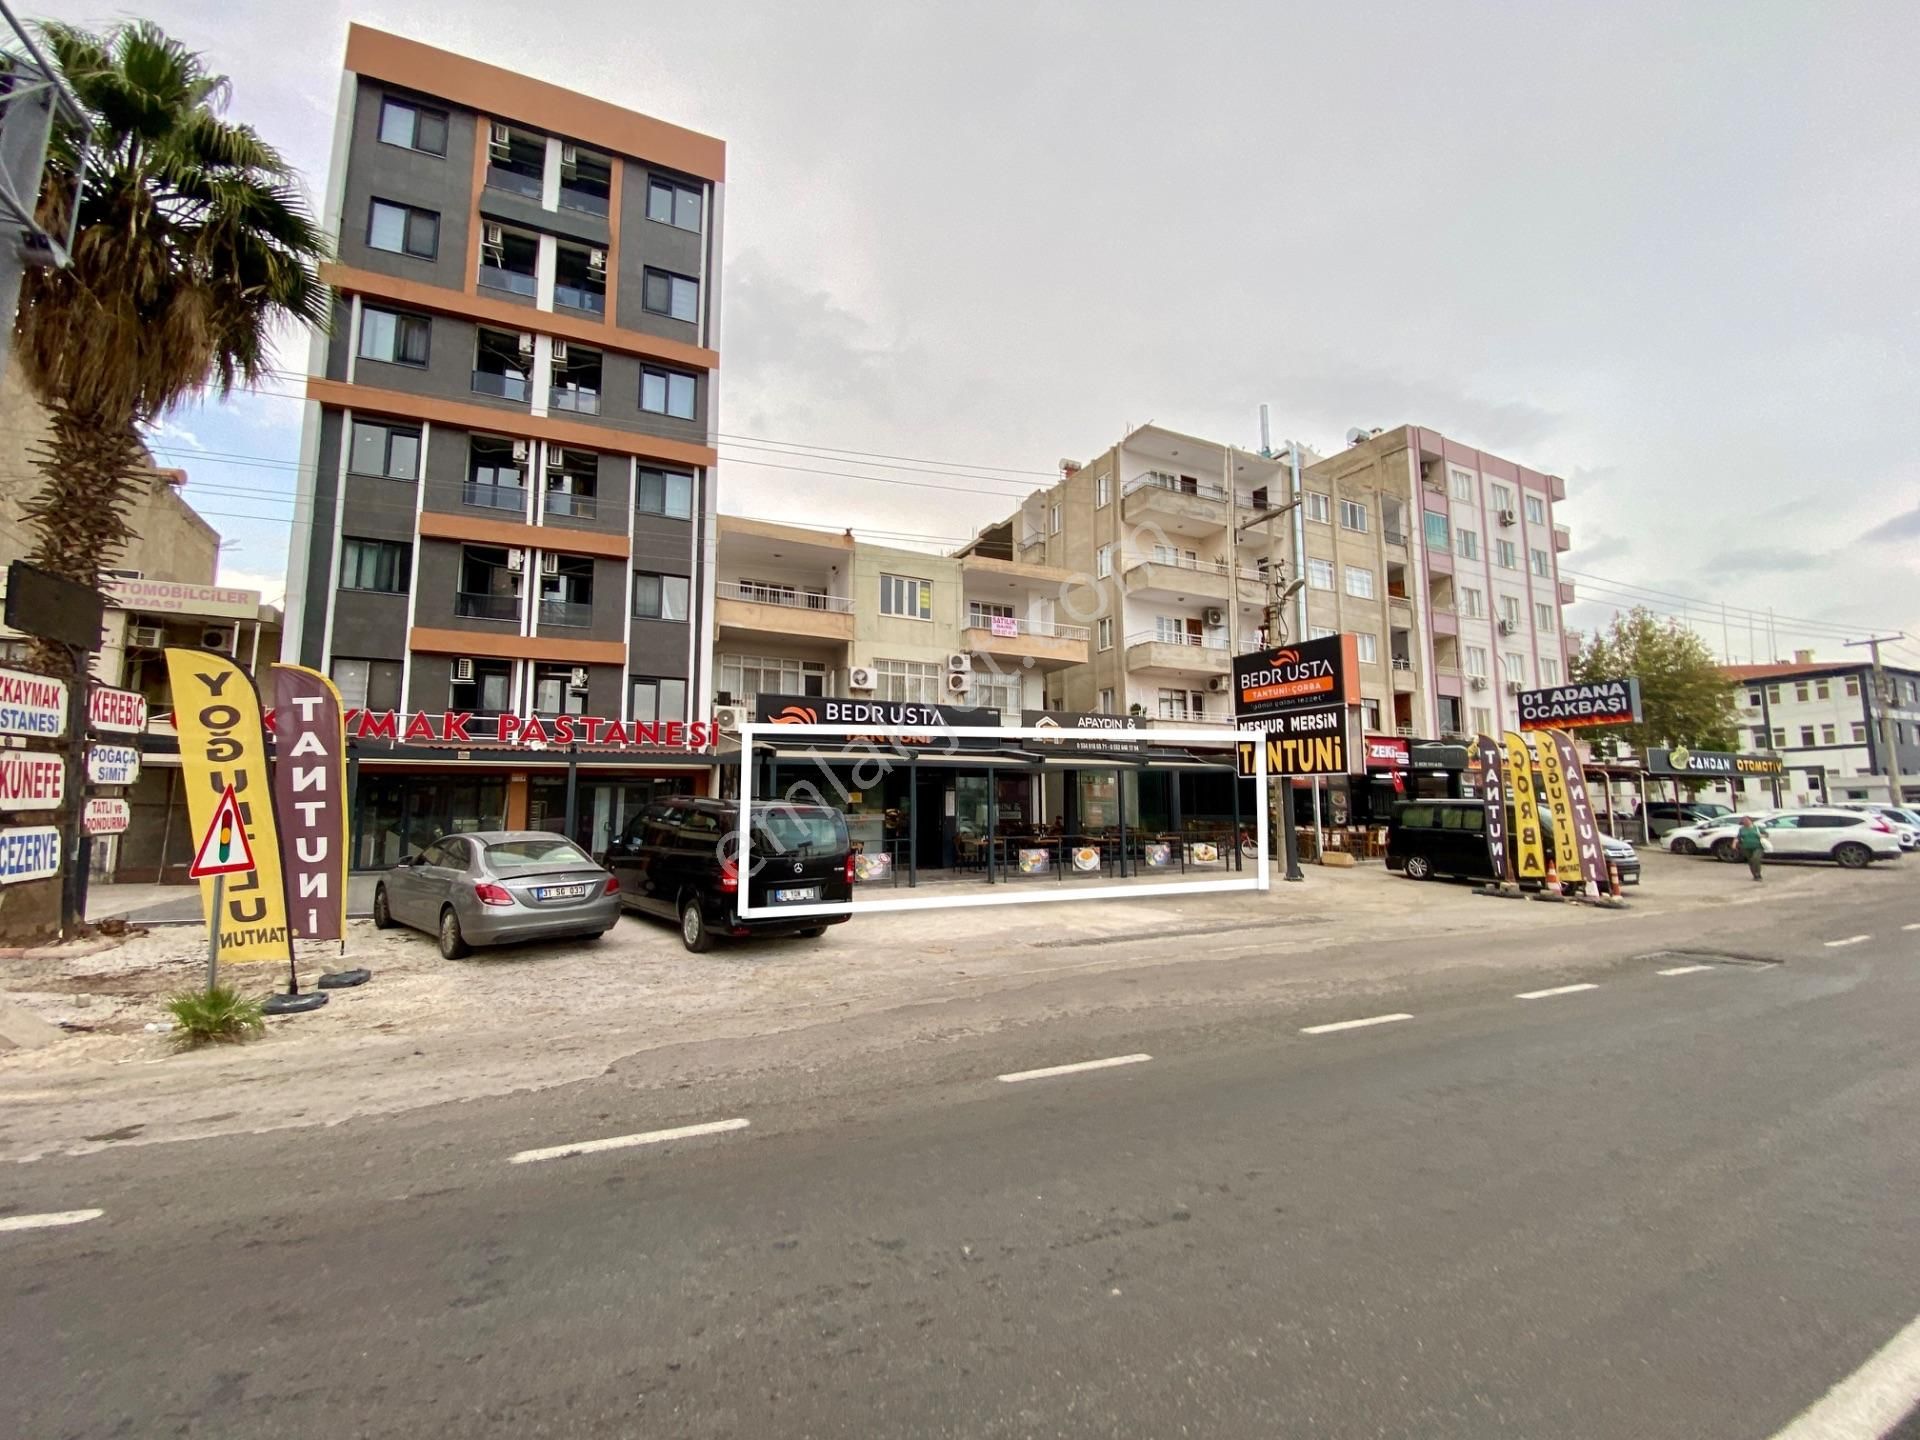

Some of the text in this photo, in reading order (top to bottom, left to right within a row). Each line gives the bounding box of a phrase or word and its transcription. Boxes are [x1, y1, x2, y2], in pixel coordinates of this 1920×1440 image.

[1241, 659, 1334, 689] BEDR USTA
[1252, 686, 1288, 698] TANTUNİ
[1522, 683, 1625, 706] 01 ADANA
[826, 703, 945, 726] BEDR USTA
[1523, 697, 1628, 721] OCAKBAŞI
[498, 713, 720, 748] PASTANESİ
[1078, 717, 1136, 729] APAYDIN &
[1290, 712, 1337, 731] MERSİN
[1239, 736, 1342, 774] TNTUNİ
[1689, 756, 1783, 773] CANDAN OTOMOTİV
[0, 753, 61, 799] KÜNEFE
[98, 767, 128, 781] SİMİT
[114, 804, 123, 814] ve
[86, 816, 127, 831] DONDURMA
[0, 833, 58, 876] CEZERYE
